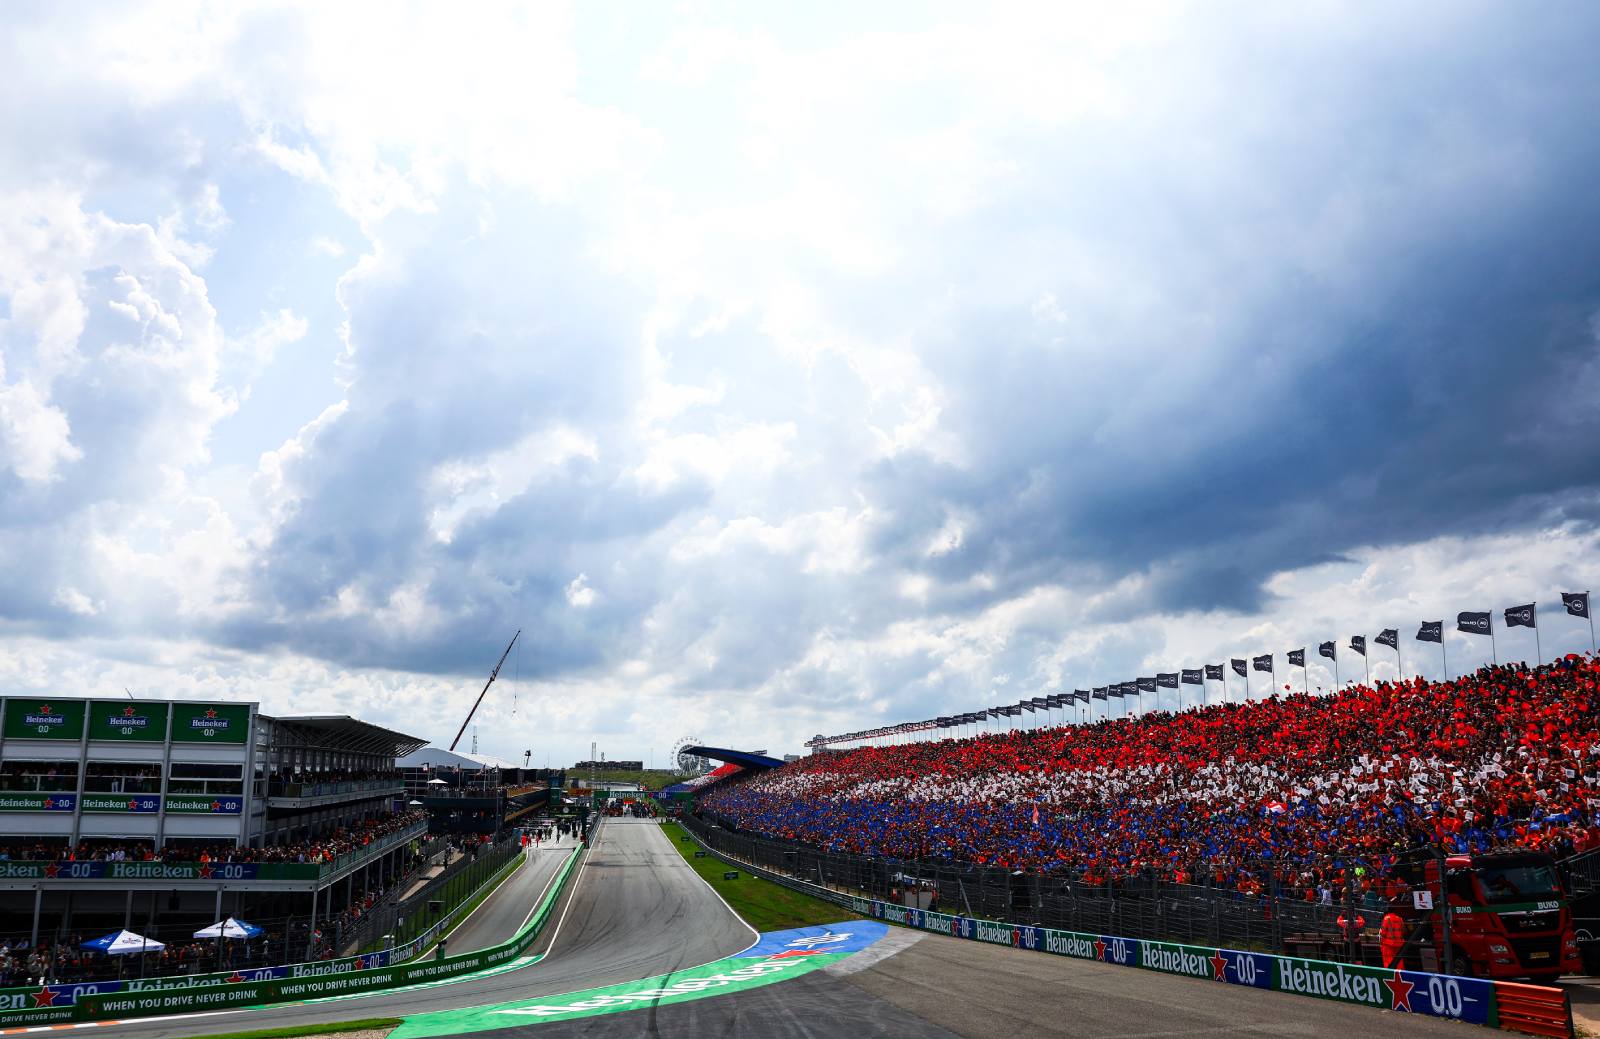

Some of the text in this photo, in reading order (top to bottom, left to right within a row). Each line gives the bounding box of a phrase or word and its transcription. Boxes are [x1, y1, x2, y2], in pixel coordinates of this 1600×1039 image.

[26, 715, 63, 724] Heineken
[109, 717, 146, 726] Heineken
[192, 719, 228, 728] Heineken
[609, 791, 645, 799] Heineken
[82, 799, 127, 809] Heineken
[166, 800, 209, 810] Heineken
[112, 863, 194, 878] Heineken
[1537, 900, 1559, 909] BUKO
[976, 921, 1011, 945] Heineken
[1045, 929, 1093, 958] Heineken
[293, 961, 352, 978] Heineken
[1141, 940, 1256, 985] Heineken 0.0
[407, 969, 424, 979] WHEN
[425, 968, 437, 976] YOU
[437, 964, 452, 973] DRIVE
[452, 962, 465, 971] NEVER
[280, 974, 392, 995] WHEN YOU DRIVE NEVER DRINK
[1278, 958, 1463, 1017] Heineken 0.0
[102, 989, 257, 1011] WHEN YOU DRIVE NEVER DRINK
[1, 1011, 72, 1023] DRIVE NEVER DRINK
